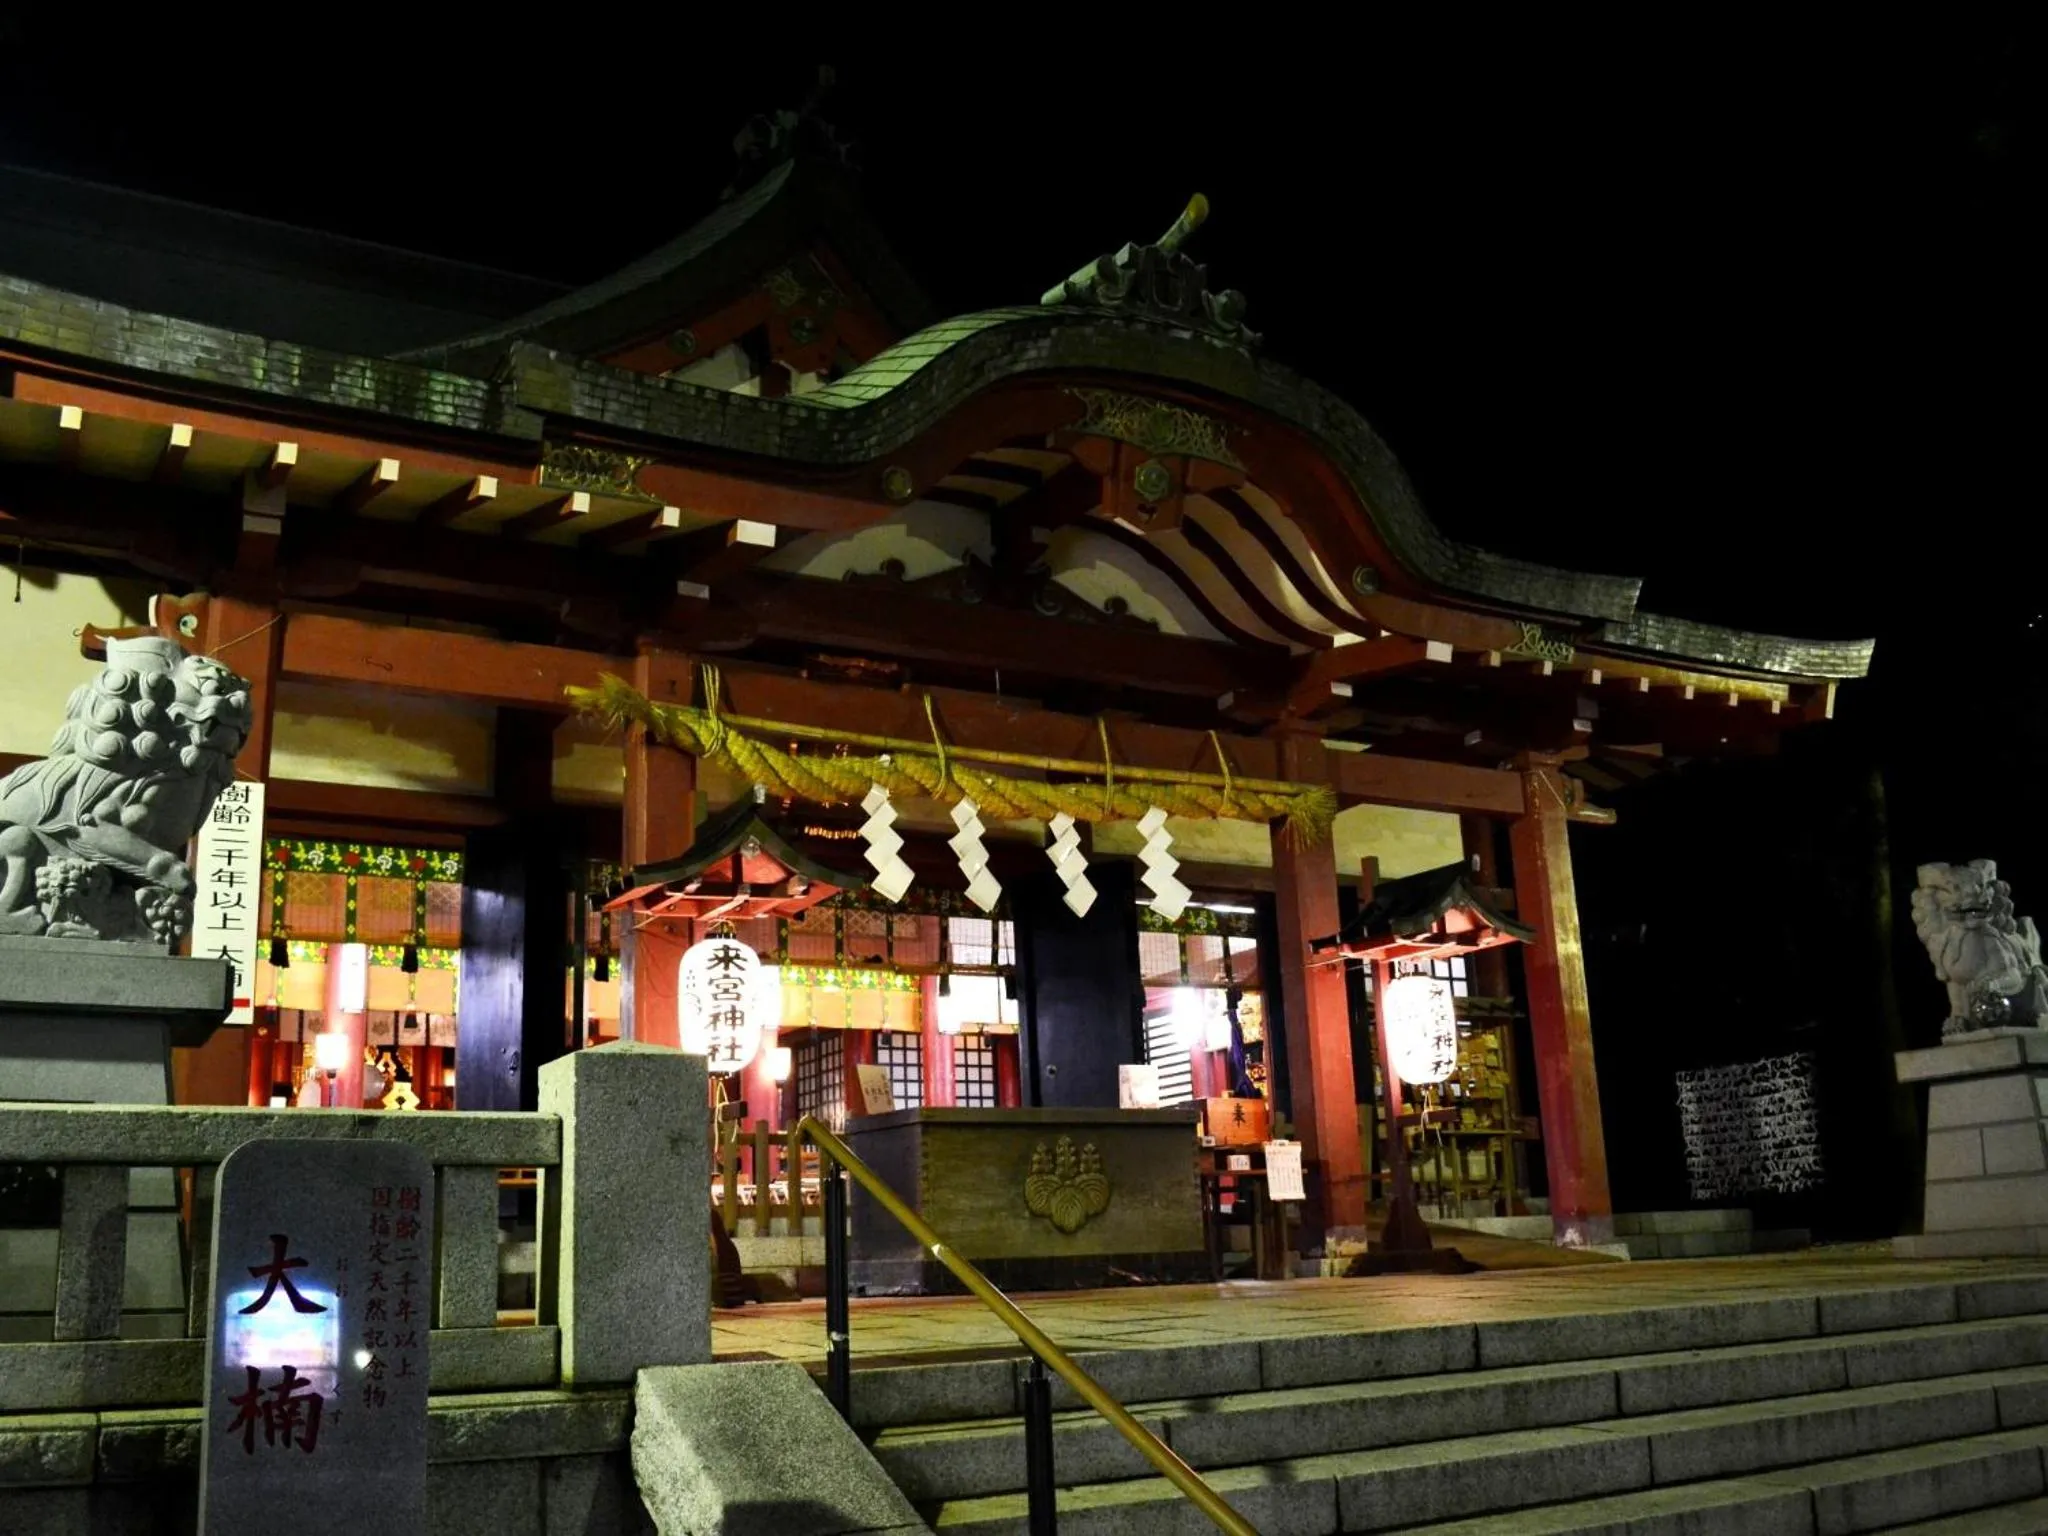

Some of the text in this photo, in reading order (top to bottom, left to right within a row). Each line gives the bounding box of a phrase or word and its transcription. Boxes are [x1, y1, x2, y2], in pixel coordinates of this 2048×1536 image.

[704, 944, 749, 1063] 来宮神社
[228, 1234, 328, 1456] 大楠
[363, 1186, 392, 1409] 国指定天然記念物
